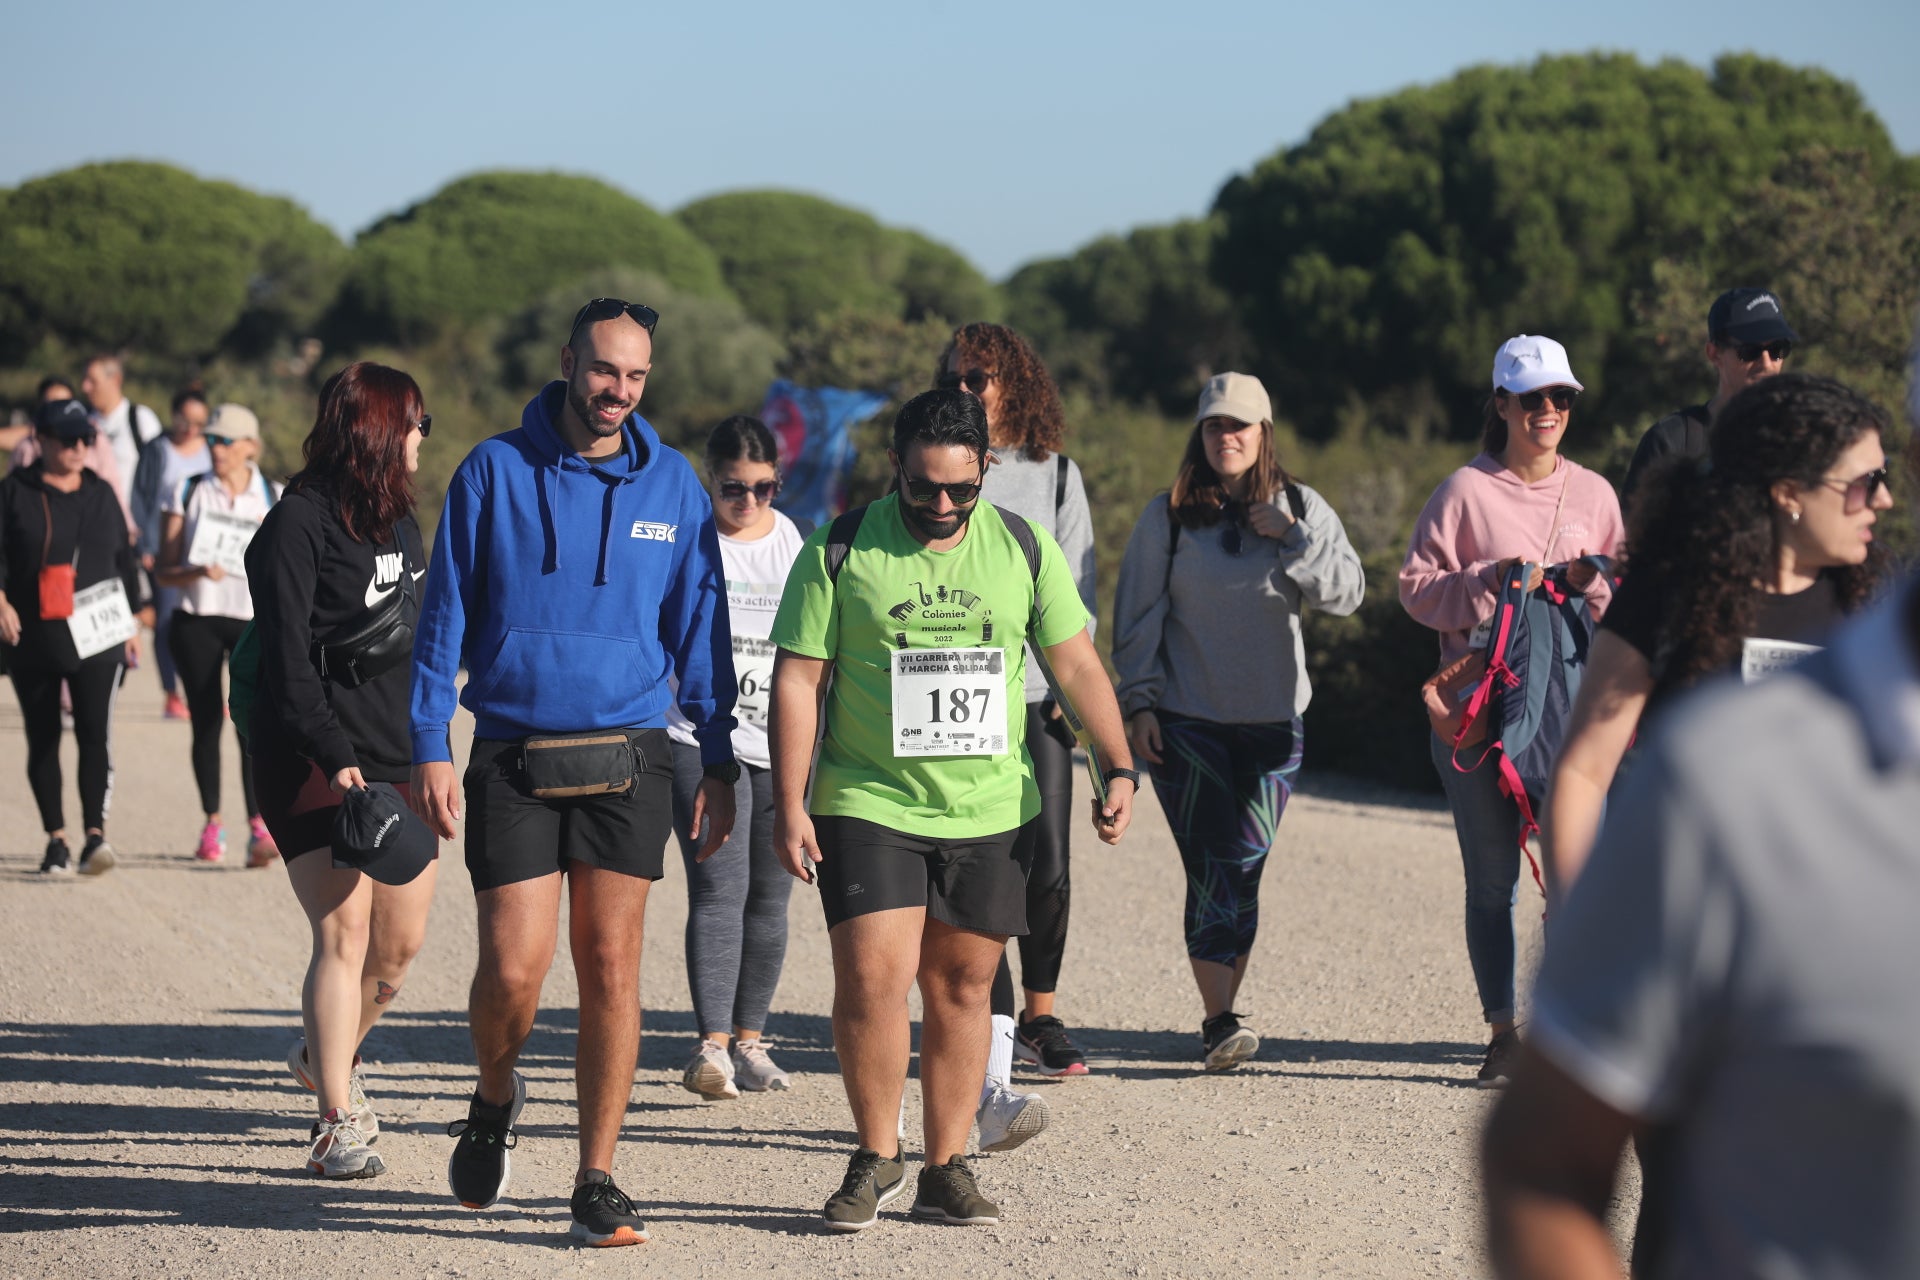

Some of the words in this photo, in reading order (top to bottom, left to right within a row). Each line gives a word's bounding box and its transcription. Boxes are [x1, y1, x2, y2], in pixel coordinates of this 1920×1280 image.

[375, 551, 404, 585] NIK
[921, 623, 966, 632] musicals
[915, 654, 960, 662] CARRERA
[908, 664, 950, 673] MARCHA
[926, 688, 991, 724] 187
